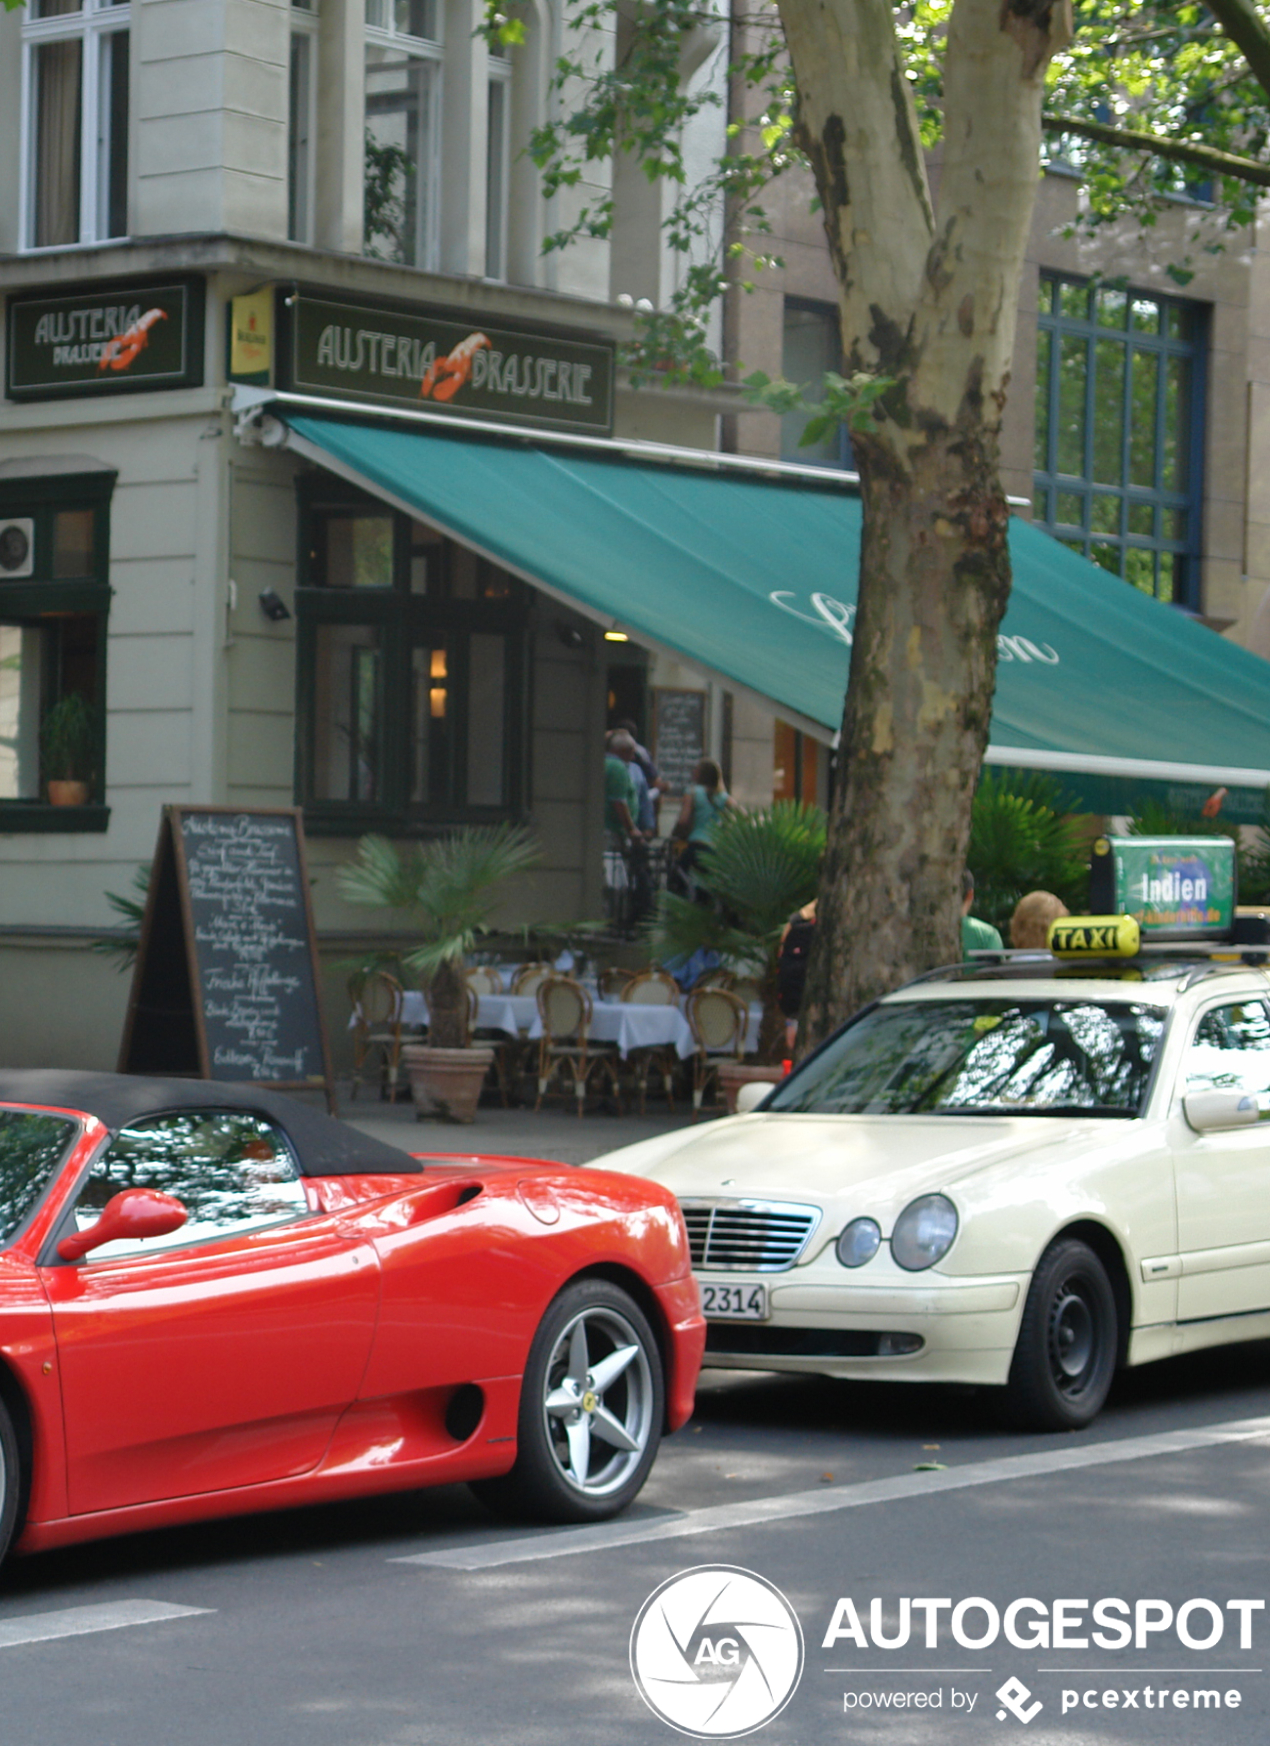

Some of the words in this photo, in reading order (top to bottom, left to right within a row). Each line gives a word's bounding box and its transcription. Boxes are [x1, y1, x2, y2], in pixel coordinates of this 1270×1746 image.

[34, 304, 140, 345] AUSTERIA
[53, 341, 122, 366] BRASSERIE
[317, 325, 436, 381] AUSTERIA
[471, 349, 593, 405] BRASSERIE
[1142, 871, 1207, 903] Indien
[1056, 927, 1116, 950] TAXI
[703, 1287, 761, 1314] 2314
